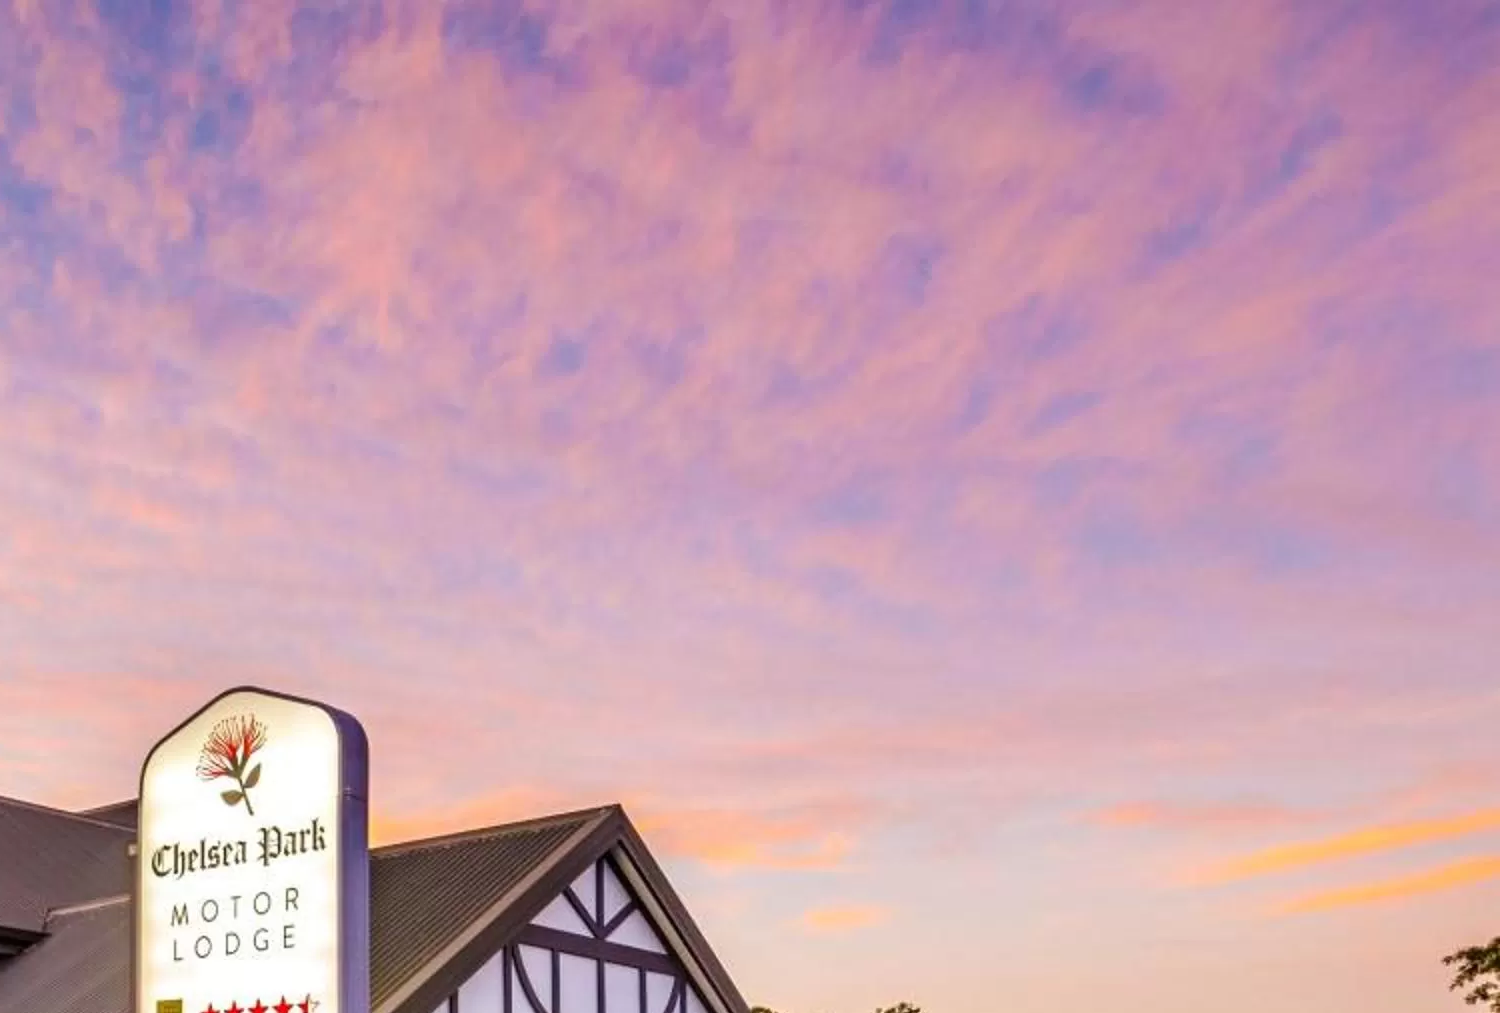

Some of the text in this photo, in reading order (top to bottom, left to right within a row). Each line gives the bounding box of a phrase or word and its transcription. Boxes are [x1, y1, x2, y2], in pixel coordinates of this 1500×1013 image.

[151, 817, 326, 880] Chelsea Park
[170, 887, 299, 926] MOTOR
[173, 924, 296, 962] LODGE
